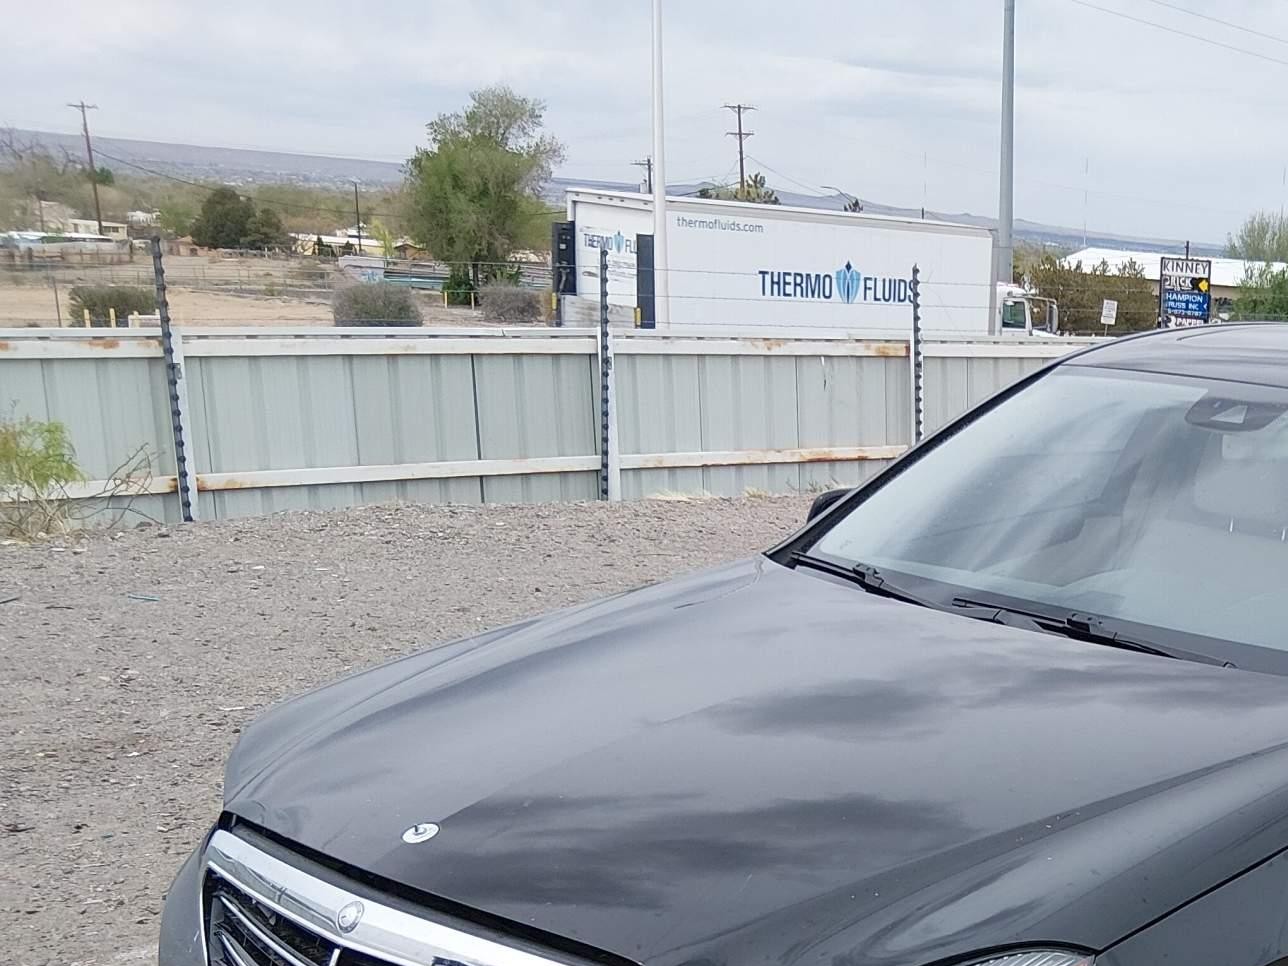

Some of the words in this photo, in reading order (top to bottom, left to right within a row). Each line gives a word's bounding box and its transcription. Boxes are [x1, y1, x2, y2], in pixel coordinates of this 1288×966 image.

[677, 216, 764, 233] thermofluids.com
[1163, 260, 1208, 275] KINNEY
[758, 270, 833, 300] THERMO
[1166, 292, 1204, 303] HAMPION
